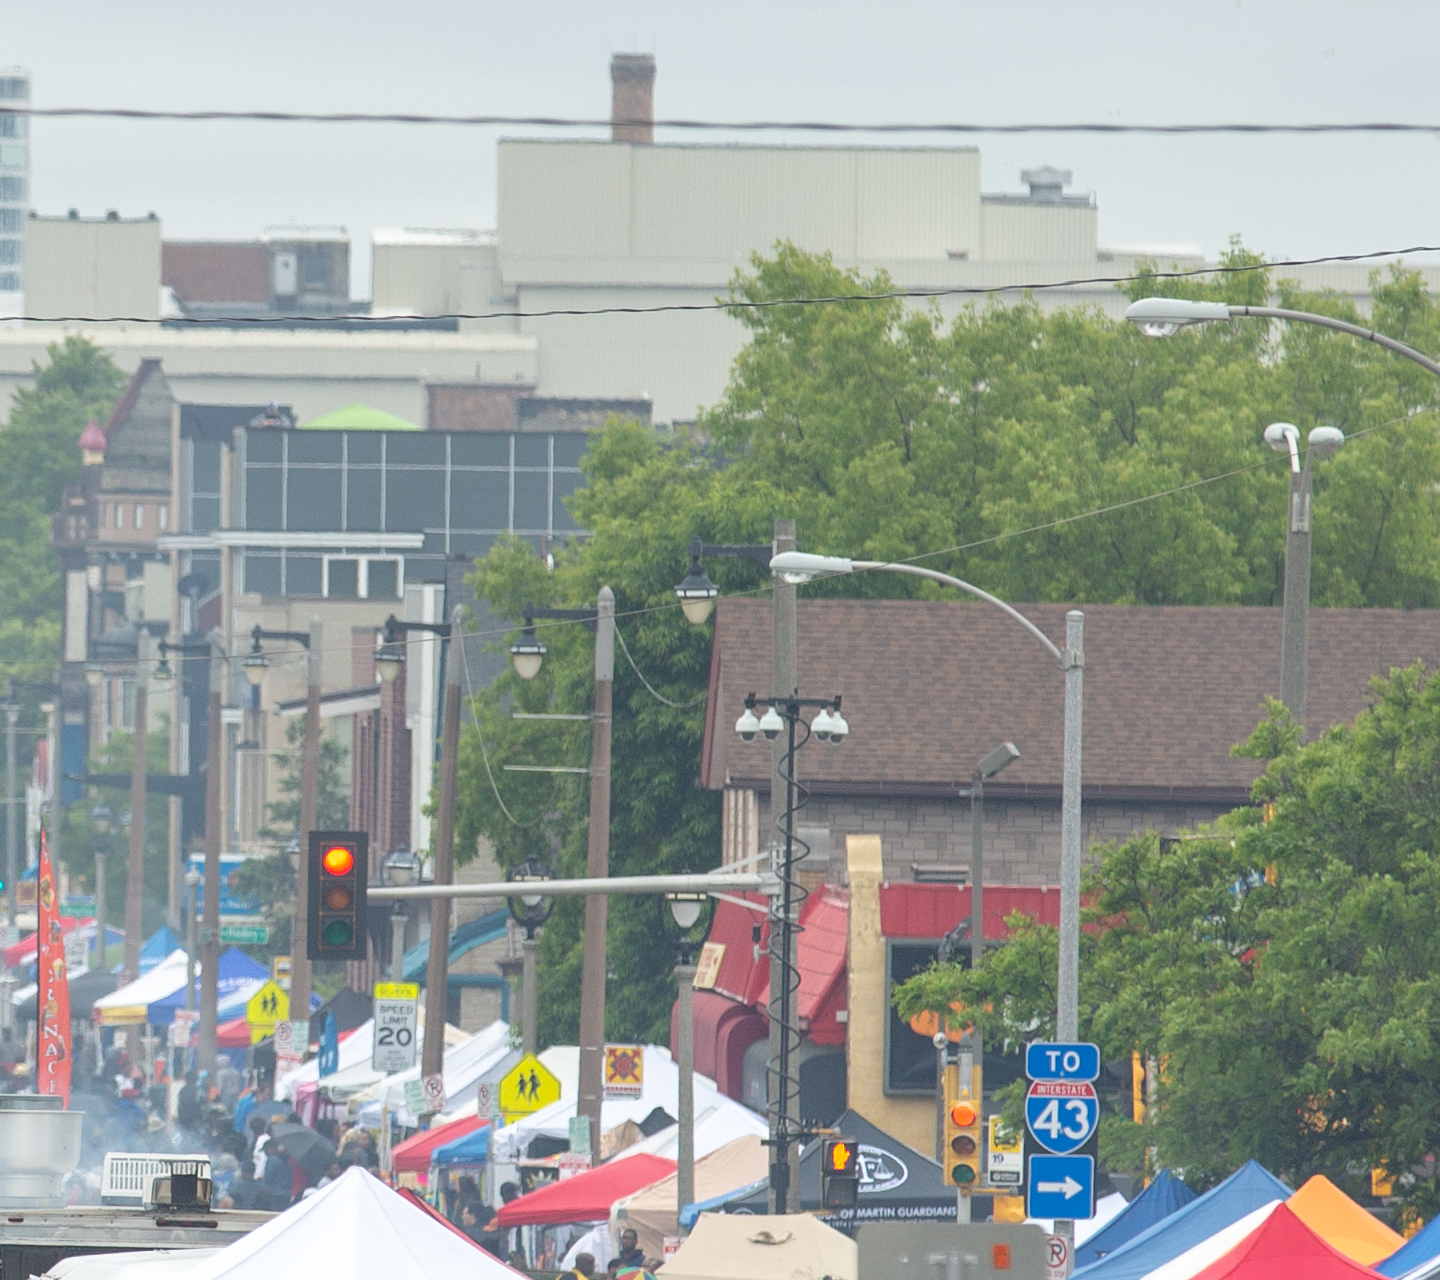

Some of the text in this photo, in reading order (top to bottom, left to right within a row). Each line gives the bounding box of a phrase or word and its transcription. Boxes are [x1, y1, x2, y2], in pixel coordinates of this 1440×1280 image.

[379, 1005, 413, 1015] SPEED
[382, 1016, 408, 1025] LIMIT
[378, 1027, 413, 1047] 20
[1045, 1051, 1081, 1073] TO
[1037, 1084, 1088, 1096] INTERSTATE
[1033, 1099, 1090, 1140] 43
[992, 1153, 1004, 1164] 19
[840, 1208, 855, 1220] OF
[856, 1207, 896, 1218] MARTIN
[897, 1205, 958, 1217] GUARDIANS
